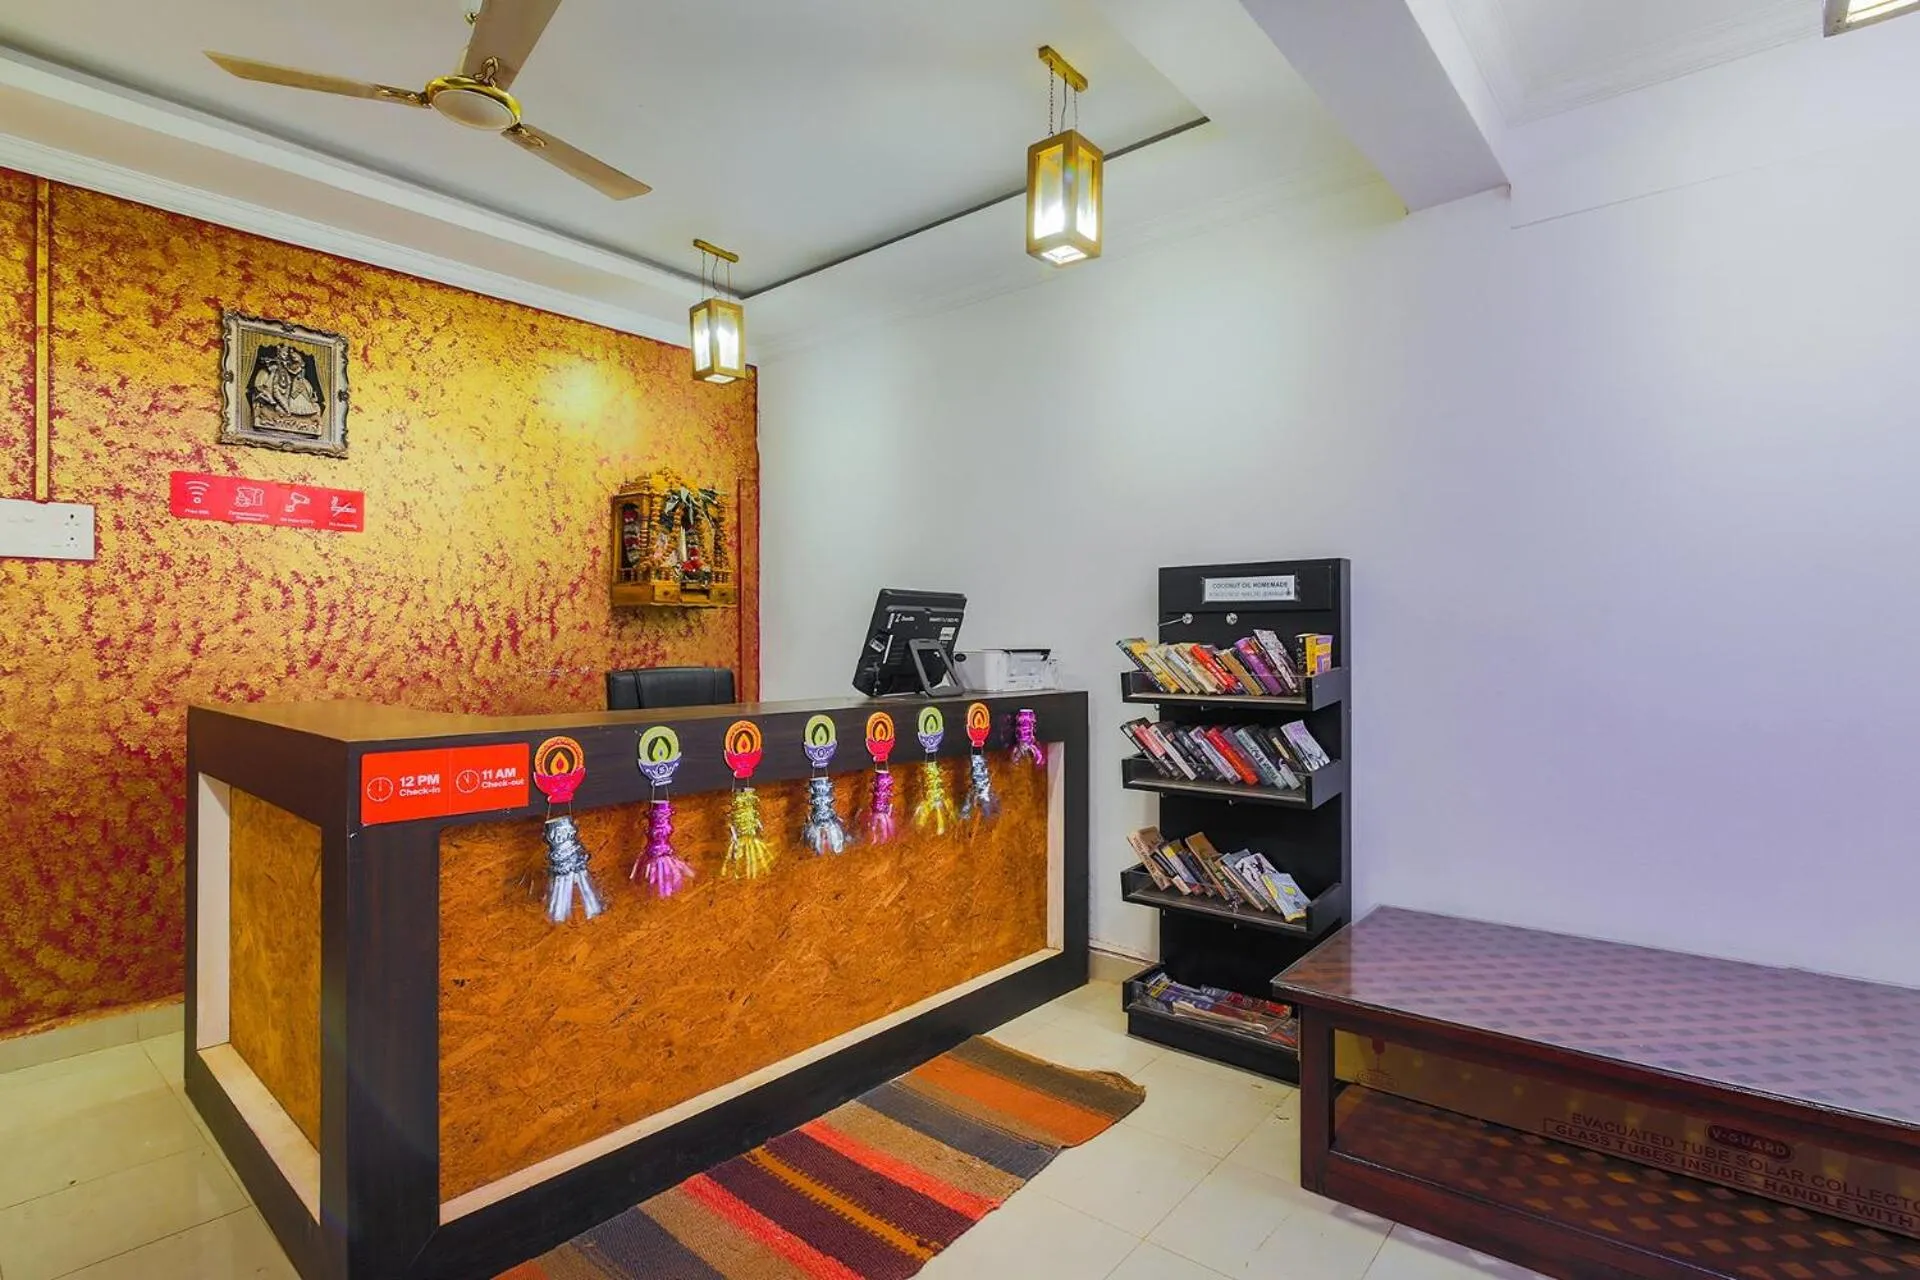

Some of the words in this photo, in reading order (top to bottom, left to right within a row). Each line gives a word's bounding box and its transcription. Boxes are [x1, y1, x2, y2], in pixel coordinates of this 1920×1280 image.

[400, 776, 414, 787] 12
[417, 774, 440, 786] PM
[482, 769, 493, 780] 11
[495, 768, 516, 779] AM
[481, 779, 524, 788] Check-out
[400, 787, 440, 796] Check-in
[1571, 1112, 1674, 1148] EVACUATED
[1681, 1140, 1729, 1162] TUBE
[1736, 1154, 1805, 1183] SOLAR
[1711, 1128, 1787, 1156] V-GUARD
[1555, 1124, 1610, 1147] GLASS
[1619, 1141, 1674, 1164] TUBES
[1682, 1157, 1746, 1184] INSIDE
[1764, 1179, 1848, 1212] HANDLE
[1856, 1203, 1914, 1228] WITH
